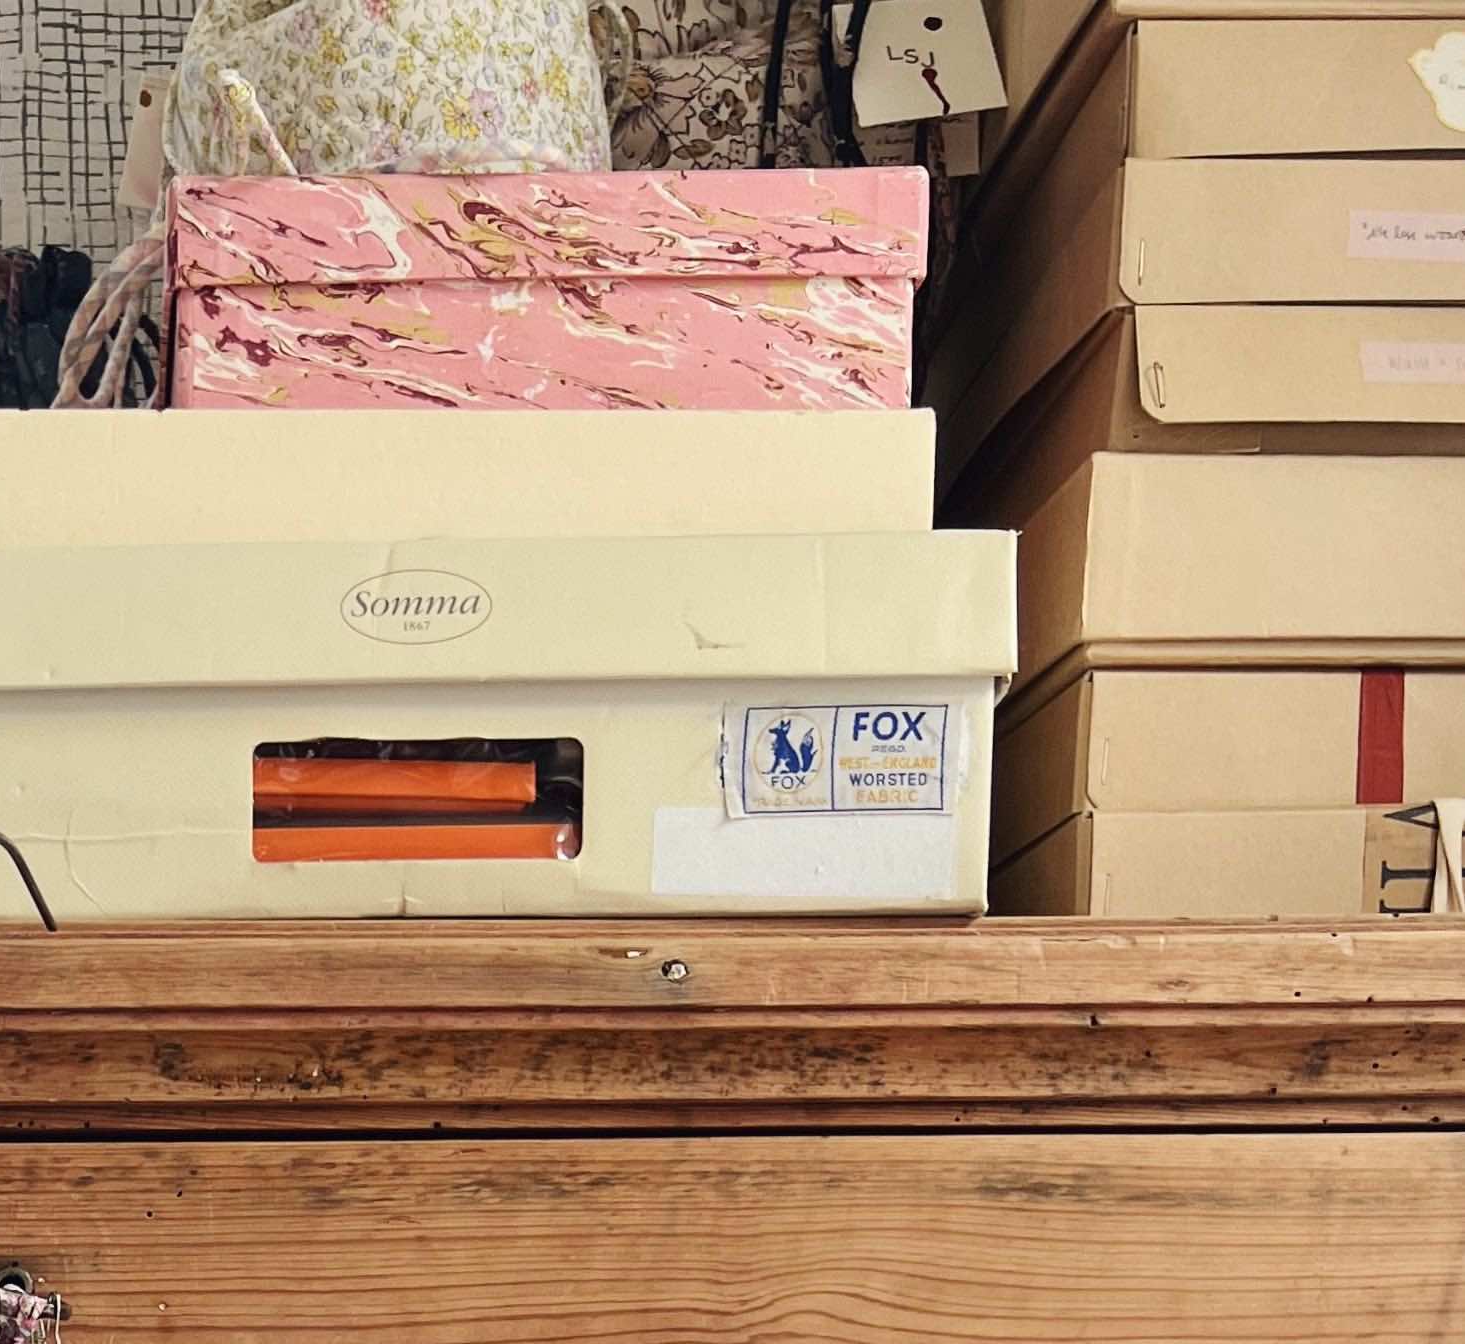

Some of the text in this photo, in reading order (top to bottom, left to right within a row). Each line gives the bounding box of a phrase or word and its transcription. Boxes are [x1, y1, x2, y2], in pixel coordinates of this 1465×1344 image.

[886, 45, 935, 68] LSJ
[351, 590, 481, 618] Somma
[403, 620, 431, 632] 1867
[852, 711, 927, 742] FOX
[770, 775, 807, 790] FOX
[849, 772, 928, 787] WORSTED
[853, 789, 920, 803] FABRIC
